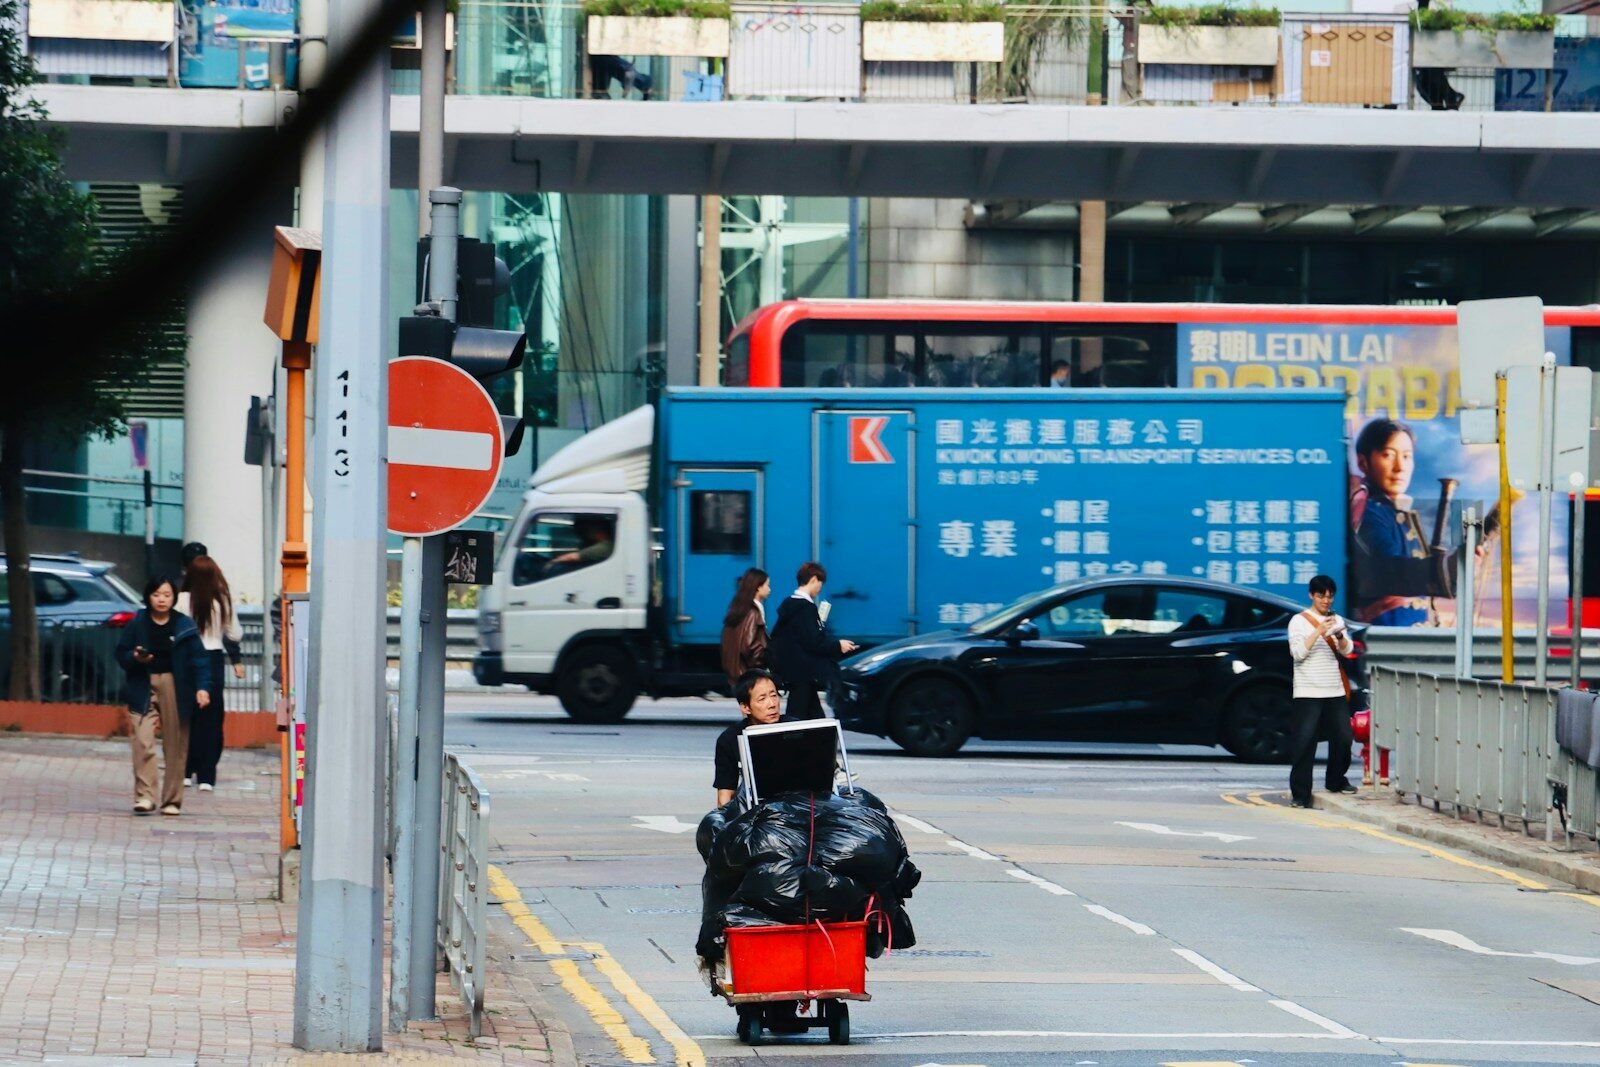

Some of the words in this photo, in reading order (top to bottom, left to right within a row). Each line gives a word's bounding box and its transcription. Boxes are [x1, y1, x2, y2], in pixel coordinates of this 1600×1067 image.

[1340, 333, 1394, 362] LAI
[936, 448, 998, 464] KWOK
[1000, 448, 1075, 464] KWONG
[1078, 448, 1196, 464] TRANSPORT
[1197, 448, 1295, 464] SERVICES
[1296, 448, 1332, 464] CO.
